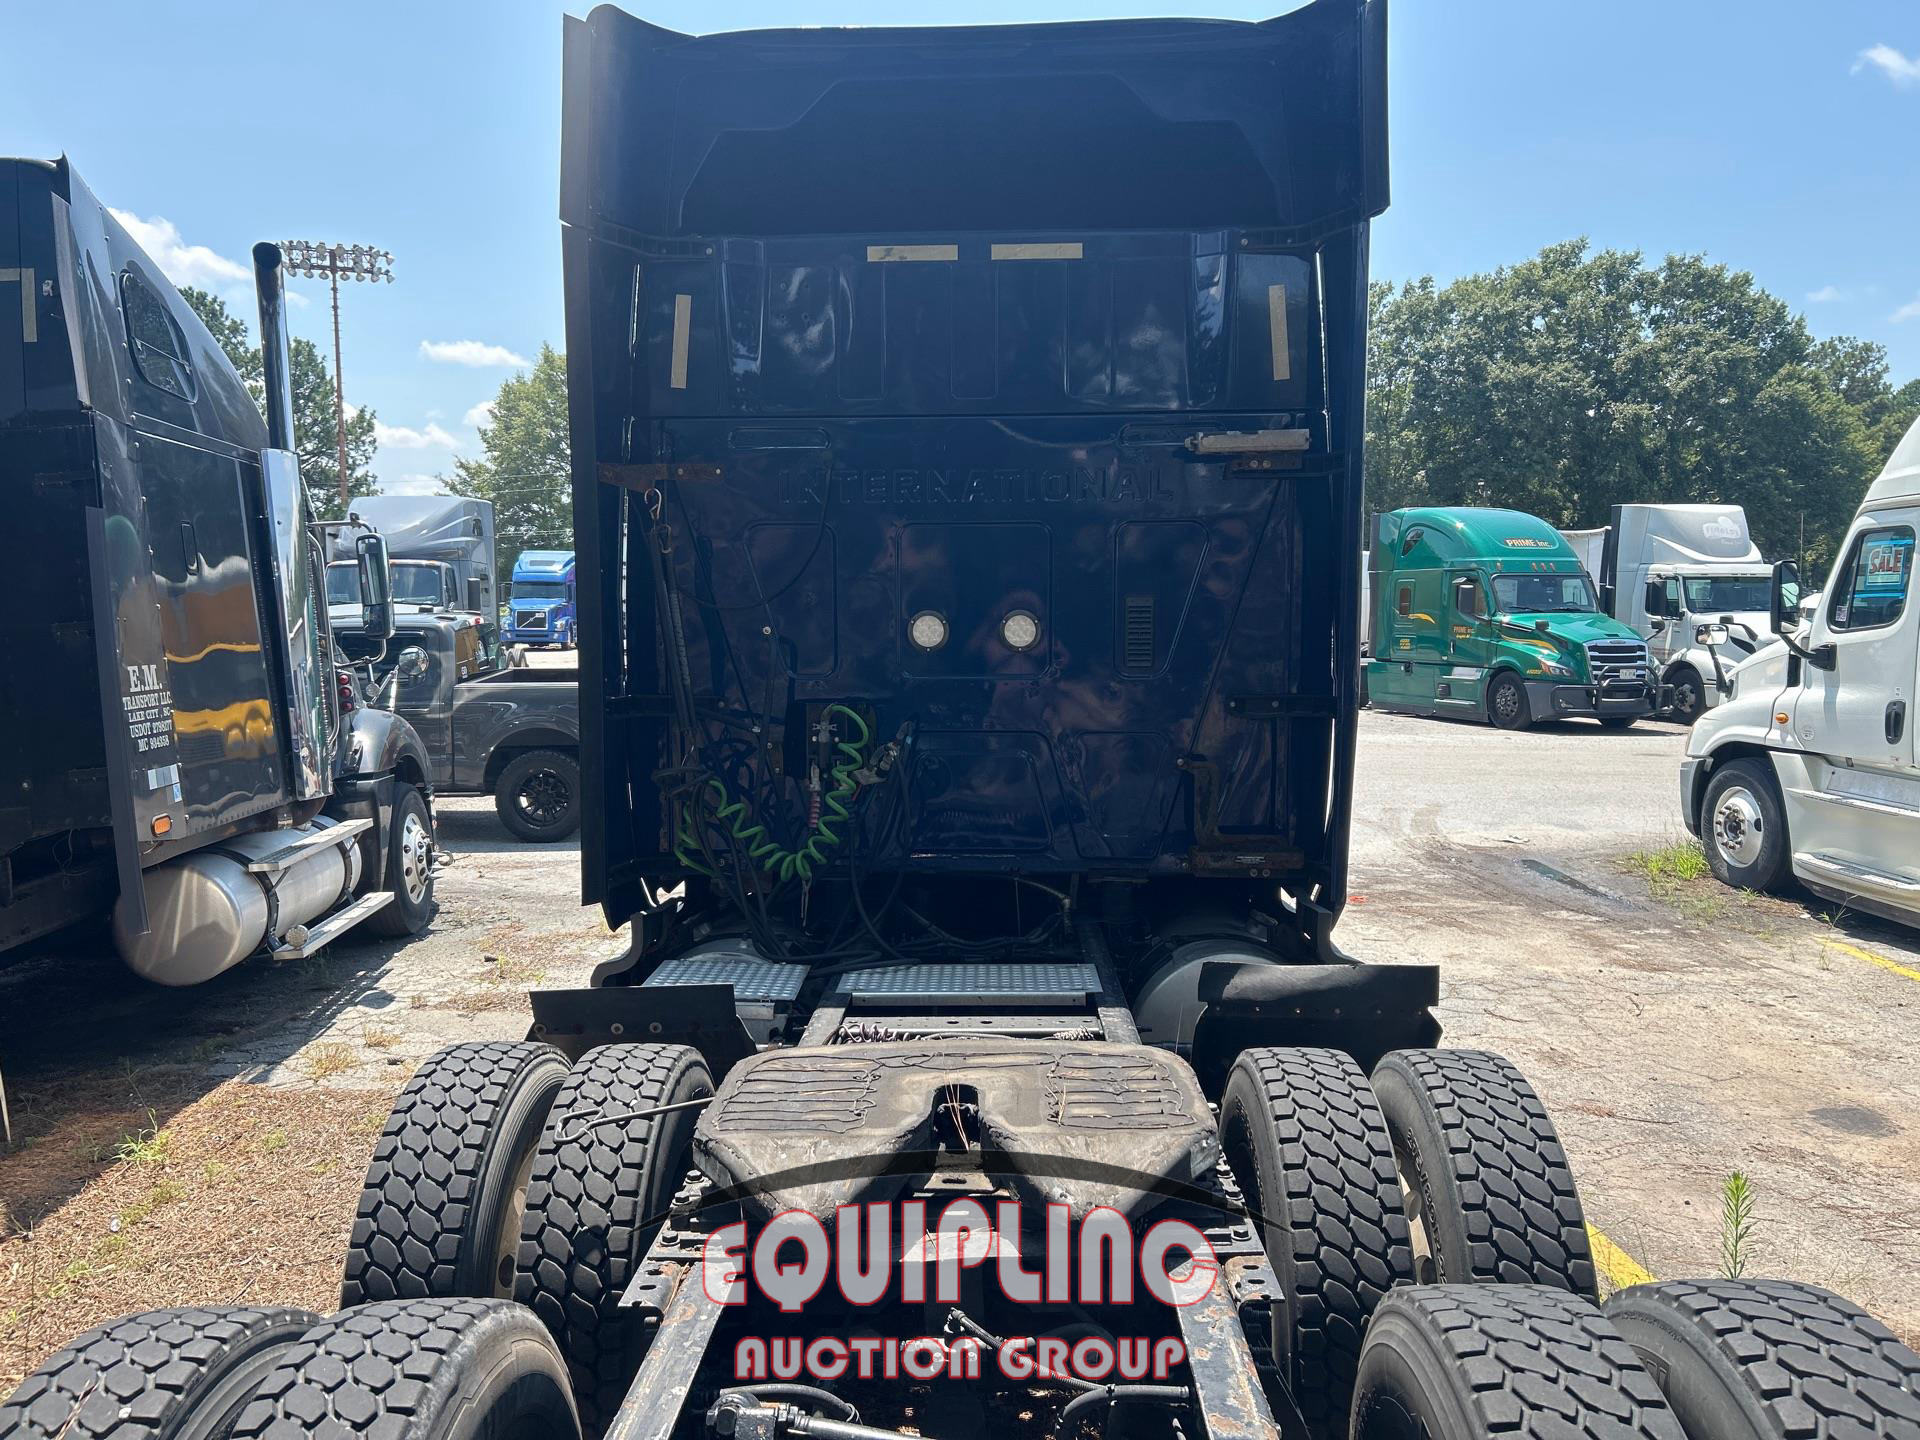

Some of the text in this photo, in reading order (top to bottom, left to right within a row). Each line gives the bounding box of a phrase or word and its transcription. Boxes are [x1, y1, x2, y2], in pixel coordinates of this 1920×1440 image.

[776, 469, 1175, 503] INTERNATIONAL
[1505, 538, 1536, 547] PRIME
[1869, 548, 1903, 573] SALE
[127, 664, 163, 692] E.M.
[122, 694, 159, 710] TRANSPORT
[128, 711, 145, 722] LAKE
[130, 722, 151, 738] USDOT
[138, 738, 149, 752] MC
